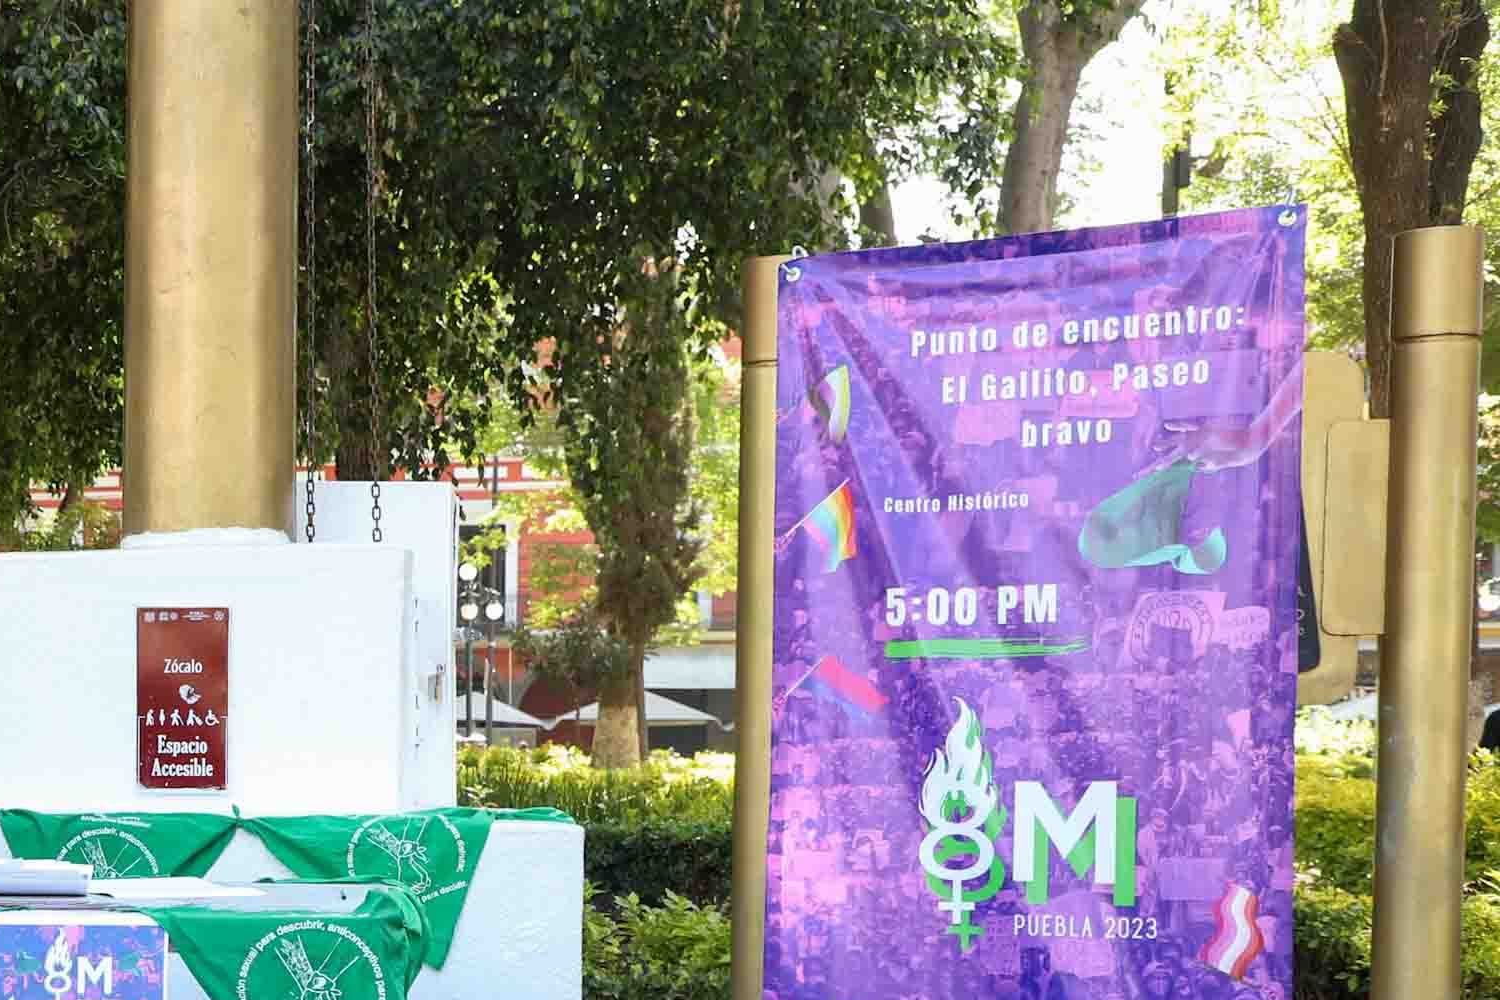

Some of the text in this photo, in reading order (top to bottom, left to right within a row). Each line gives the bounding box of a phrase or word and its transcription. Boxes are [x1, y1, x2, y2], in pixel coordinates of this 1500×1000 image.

[911, 303, 1245, 357] Punto de encuentro:
[941, 359, 1211, 404] El Gallito, Paseo
[1021, 418, 1113, 449] bravo
[883, 491, 1029, 513] Centro Histórico
[884, 583, 1058, 627] 5:00 PM
[163, 657, 203, 674] Zócalo
[157, 734, 209, 757] Espacio
[151, 757, 214, 777] Accesible
[1012, 913, 1158, 940] PUEBLA 2023
[239, 947, 258, 978] sexual
[255, 931, 277, 952] para
[276, 920, 325, 936] descubrir,
[327, 923, 383, 979] anticonceptivos
